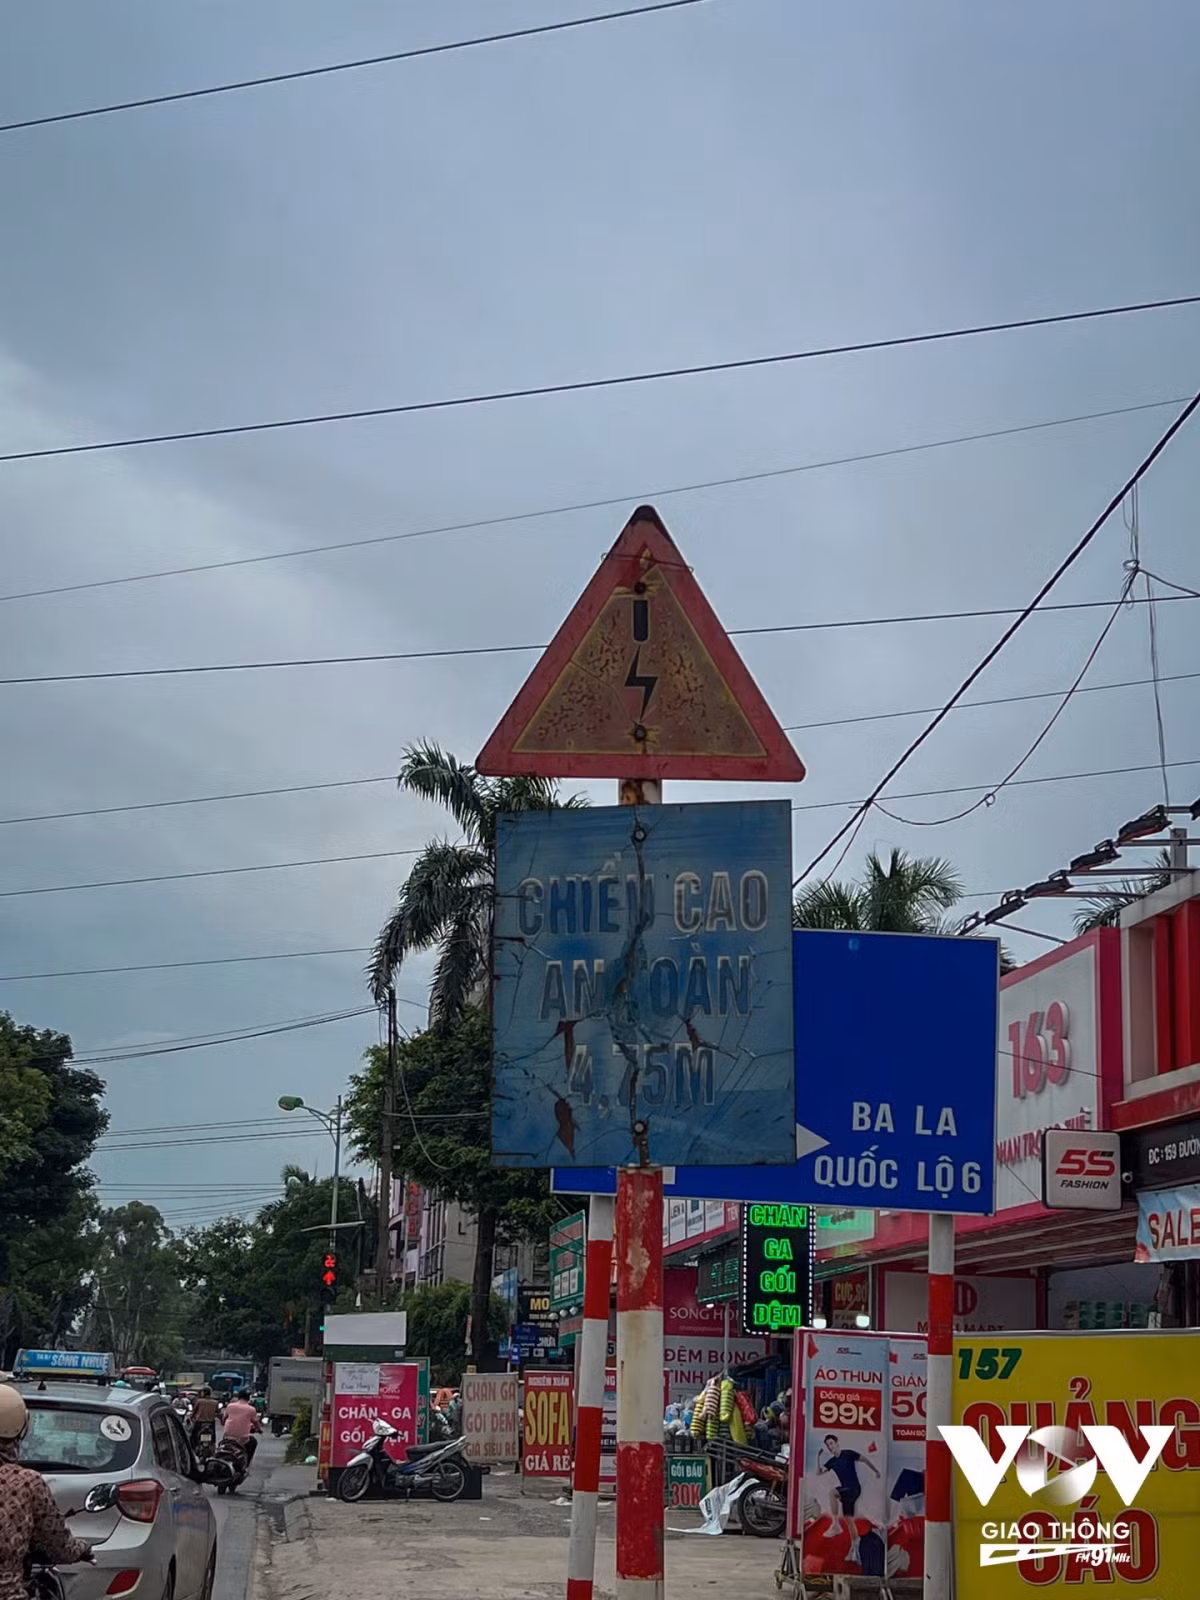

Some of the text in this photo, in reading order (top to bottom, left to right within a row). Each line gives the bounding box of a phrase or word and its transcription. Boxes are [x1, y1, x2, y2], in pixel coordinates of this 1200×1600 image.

[674, 869, 769, 934] CAO
[538, 942, 751, 1021] AN OÀN
[1008, 1001, 1071, 1099] 163
[852, 1101, 958, 1136] BA LA
[814, 1145, 899, 1189] QUỐC
[1055, 1149, 1117, 1177] 5S
[1060, 1179, 1109, 1190] FASHION
[750, 1203, 807, 1228] CHĂN
[1147, 1208, 1200, 1250] SALE
[764, 1238, 793, 1260] GA
[760, 1265, 796, 1293] GỐI
[753, 1300, 801, 1330] ĐỆM
[664, 1346, 702, 1367] ĐỆM
[958, 1347, 1023, 1380] 157
[814, 1365, 883, 1383] ÁO THUN
[500, 1381, 516, 1402] GA
[339, 1404, 378, 1420] CHĂN
[391, 1407, 411, 1420] GA
[525, 1391, 570, 1446] SOFA
[819, 1401, 876, 1426] 99K
[340, 1425, 365, 1443] GỐI
[525, 1449, 571, 1471] GIÁ RẺ
[1016, 1495, 1160, 1586] CÁO
